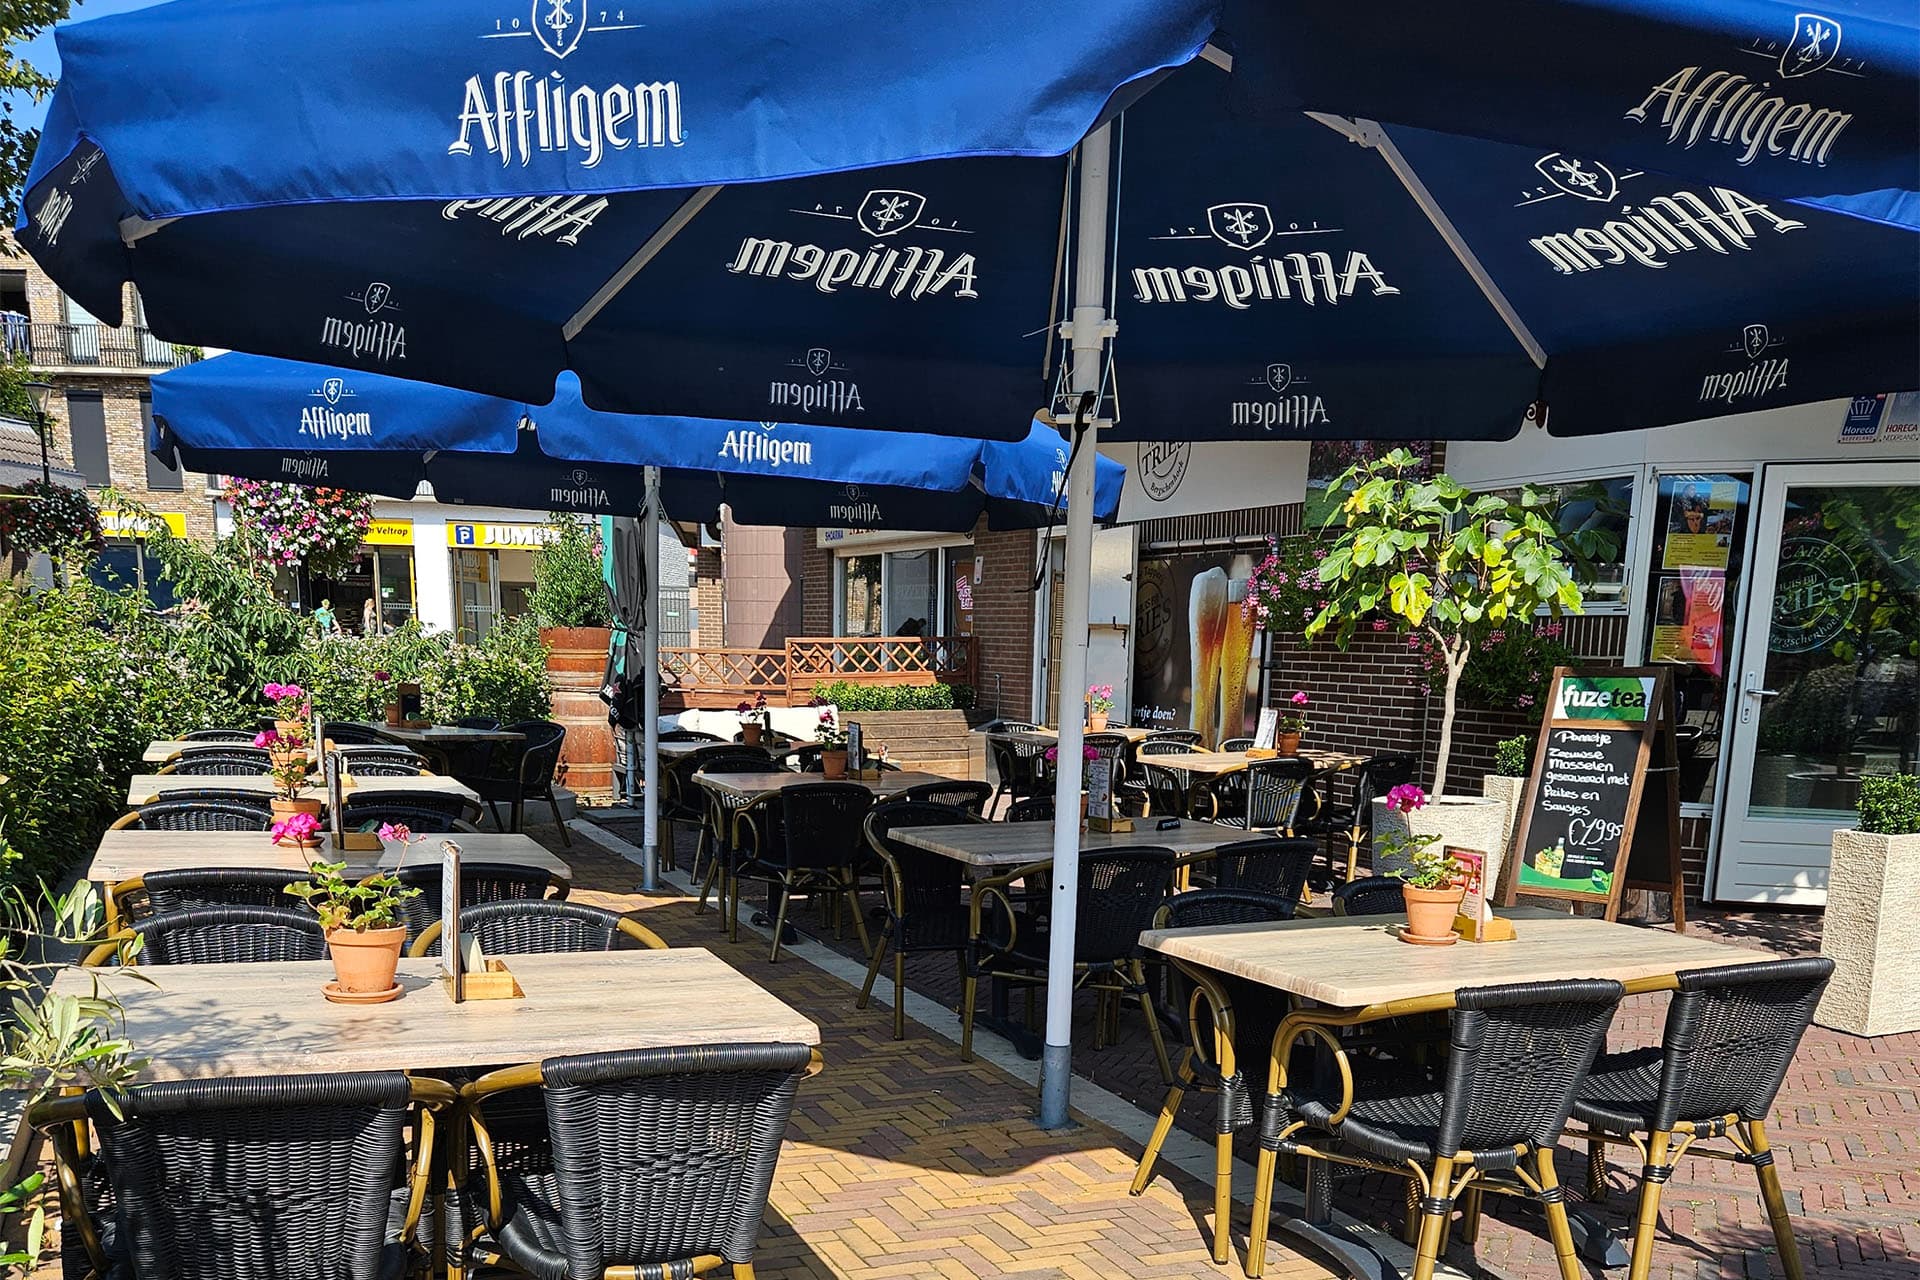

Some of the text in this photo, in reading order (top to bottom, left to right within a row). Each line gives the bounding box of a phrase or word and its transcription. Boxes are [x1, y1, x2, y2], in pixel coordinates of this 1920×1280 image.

[448, 70, 686, 168] Affligem
[1624, 66, 1853, 167] Affligem
[298, 406, 373, 440] Affligem
[1844, 426, 1876, 434] Horeca
[1886, 424, 1918, 432] HORECA
[718, 430, 813, 468] Affligem
[377, 527, 408, 536] Veltrop
[1775, 576, 1844, 615] RIES
[1135, 600, 1172, 638] RIES
[1770, 614, 1841, 648] ergschenhoek
[1152, 705, 1176, 721] doen?
[1549, 759, 1614, 772] Mosselen
[1607, 773, 1630, 785] met
[1581, 791, 1600, 801] en
